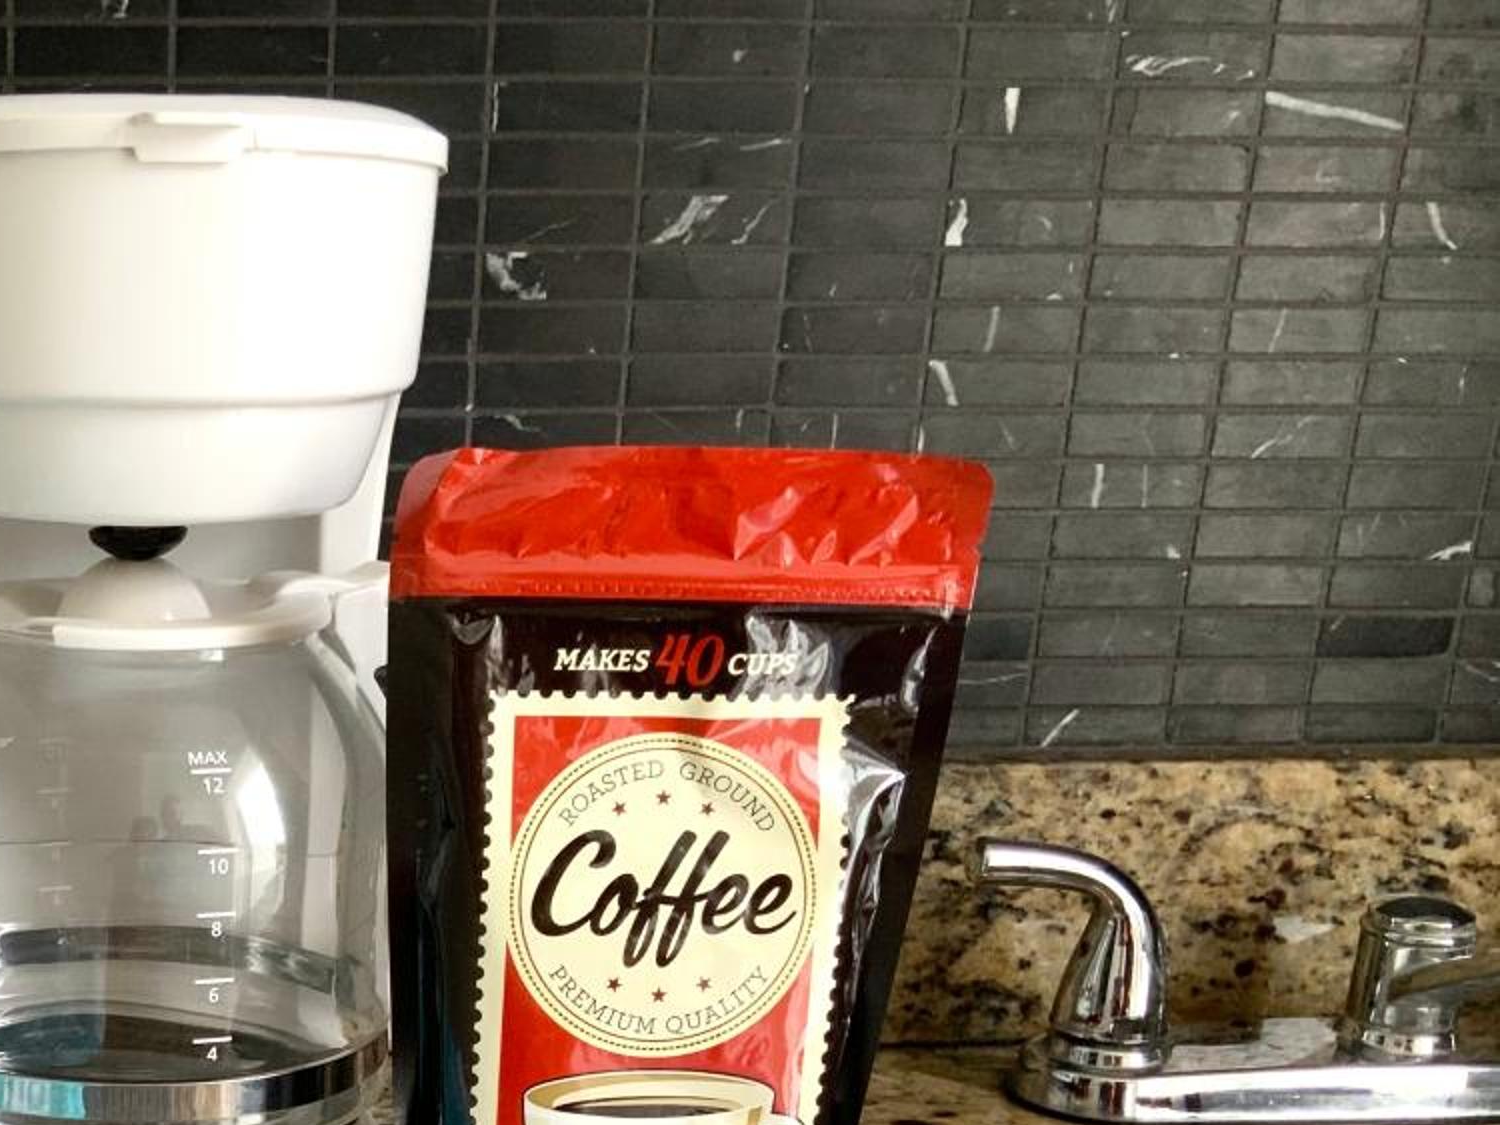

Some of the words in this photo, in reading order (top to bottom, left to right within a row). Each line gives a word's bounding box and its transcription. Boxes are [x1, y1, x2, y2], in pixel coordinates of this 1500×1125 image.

[553, 647, 651, 672] MAKES
[655, 634, 725, 688] 40
[727, 652, 799, 676] CUPS
[187, 751, 228, 766] MAX
[203, 777, 226, 795] 12
[558, 760, 665, 827] ROASTED
[679, 760, 775, 832] GROUND
[208, 858, 229, 875] 10
[530, 830, 797, 968] Coffee
[210, 921, 222, 937] 8
[208, 987, 219, 1004] 6
[549, 964, 655, 1035] PREMIUM
[665, 964, 769, 1035] QUALITY
[206, 1046, 218, 1062] 4
